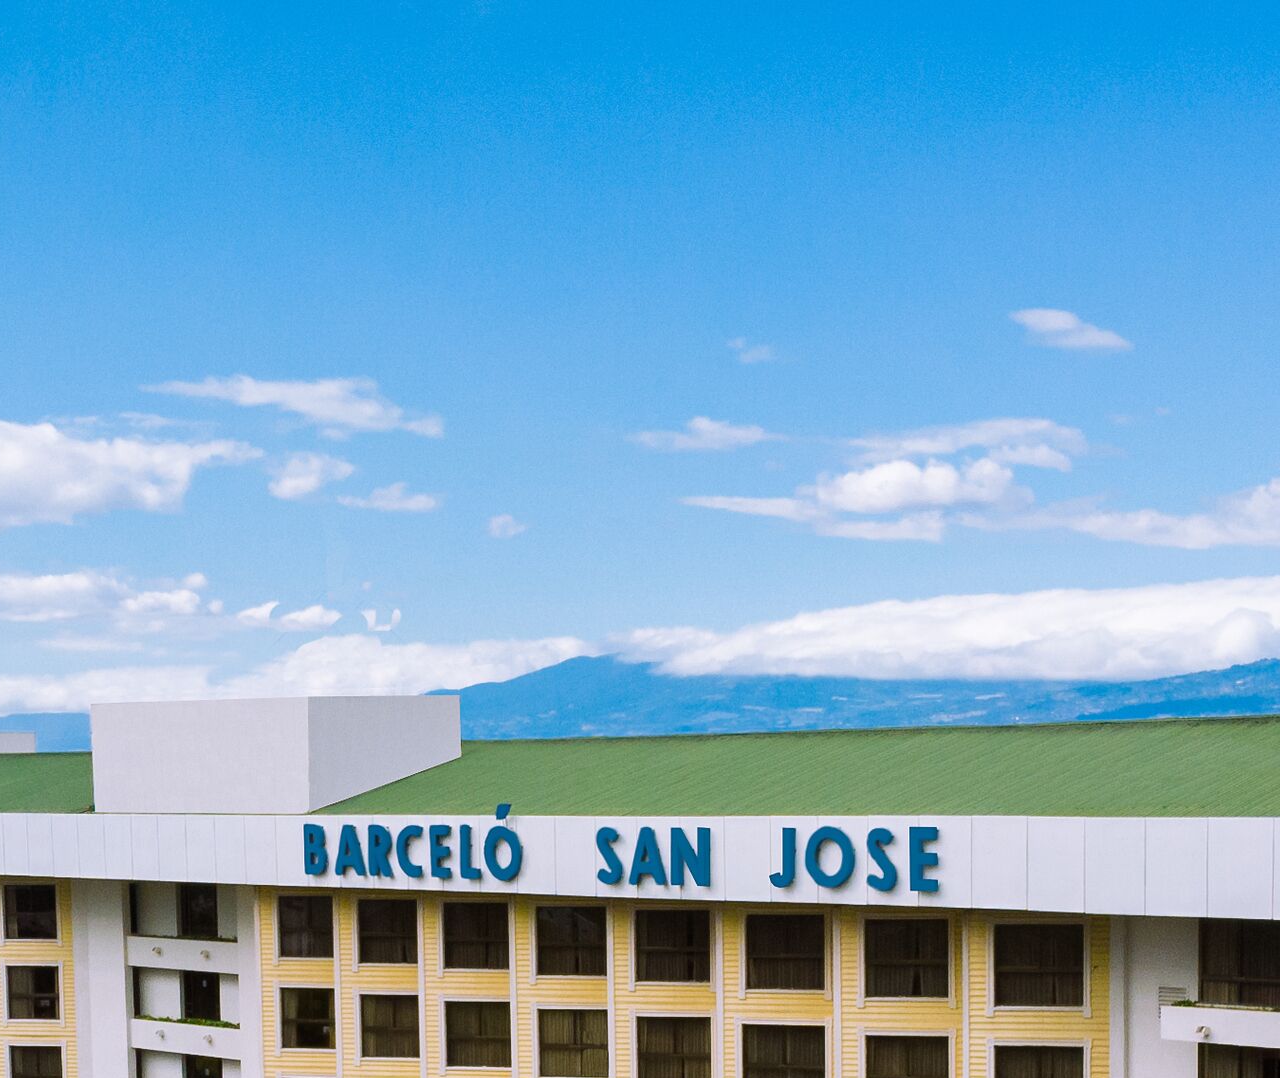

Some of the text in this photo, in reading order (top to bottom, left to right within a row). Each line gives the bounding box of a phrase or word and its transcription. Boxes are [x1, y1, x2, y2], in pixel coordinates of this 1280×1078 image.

[303, 803, 939, 892] BARCELÓ SAN JOSE
